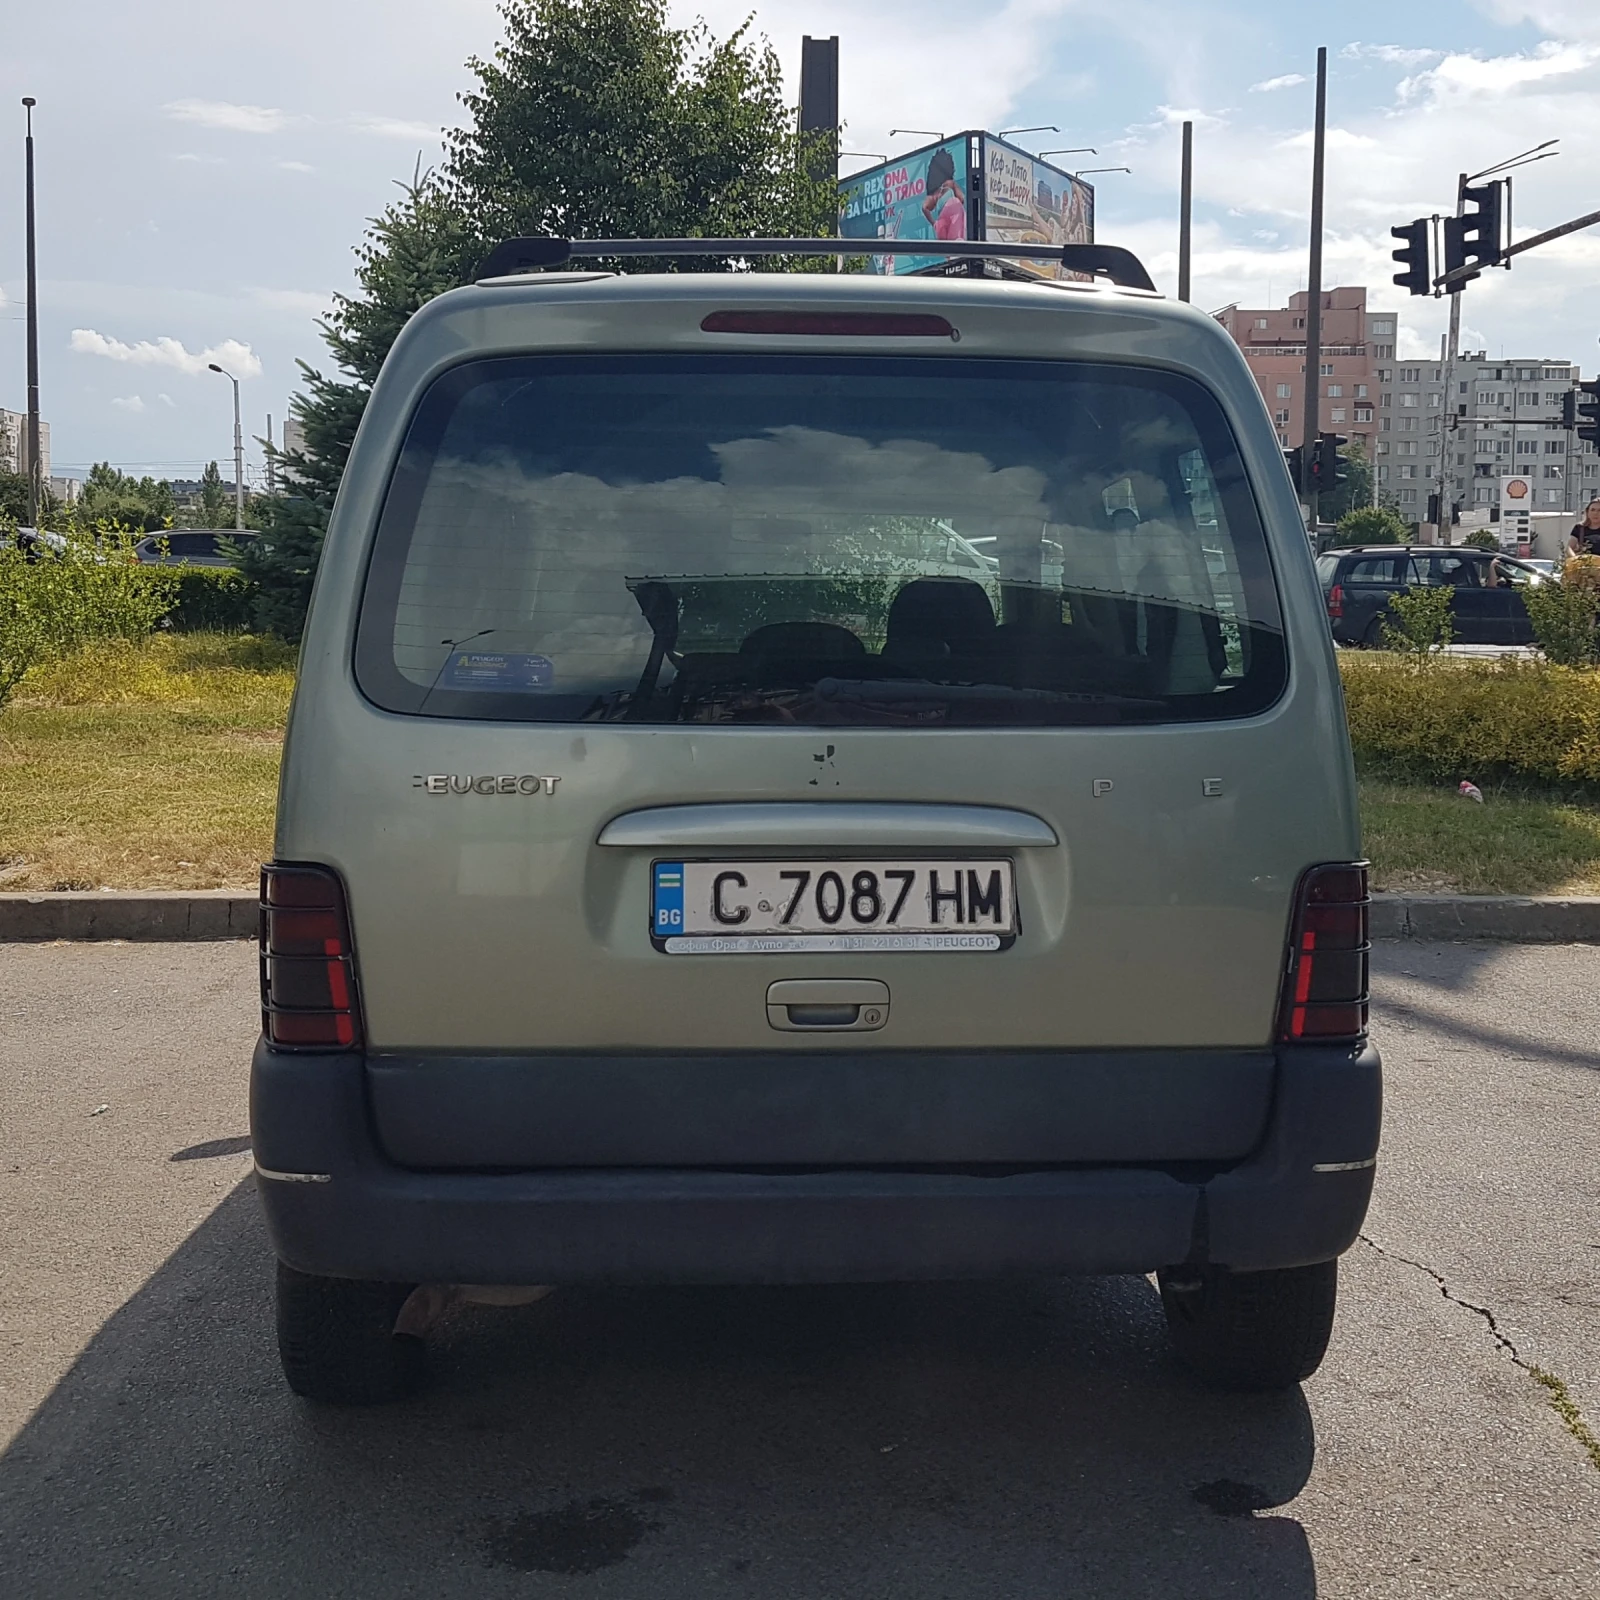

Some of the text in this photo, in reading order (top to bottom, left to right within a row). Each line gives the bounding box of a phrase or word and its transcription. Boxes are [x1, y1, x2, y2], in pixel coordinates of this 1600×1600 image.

[864, 167, 908, 197] REXONA
[846, 178, 925, 219] ЗА ЦЯЛО ТЯЛО
[413, 774, 562, 796] EUGEOT
[713, 869, 1003, 925] C 7087 HM
[659, 908, 681, 925] BG
[936, 936, 992, 948] PEUGEOT
